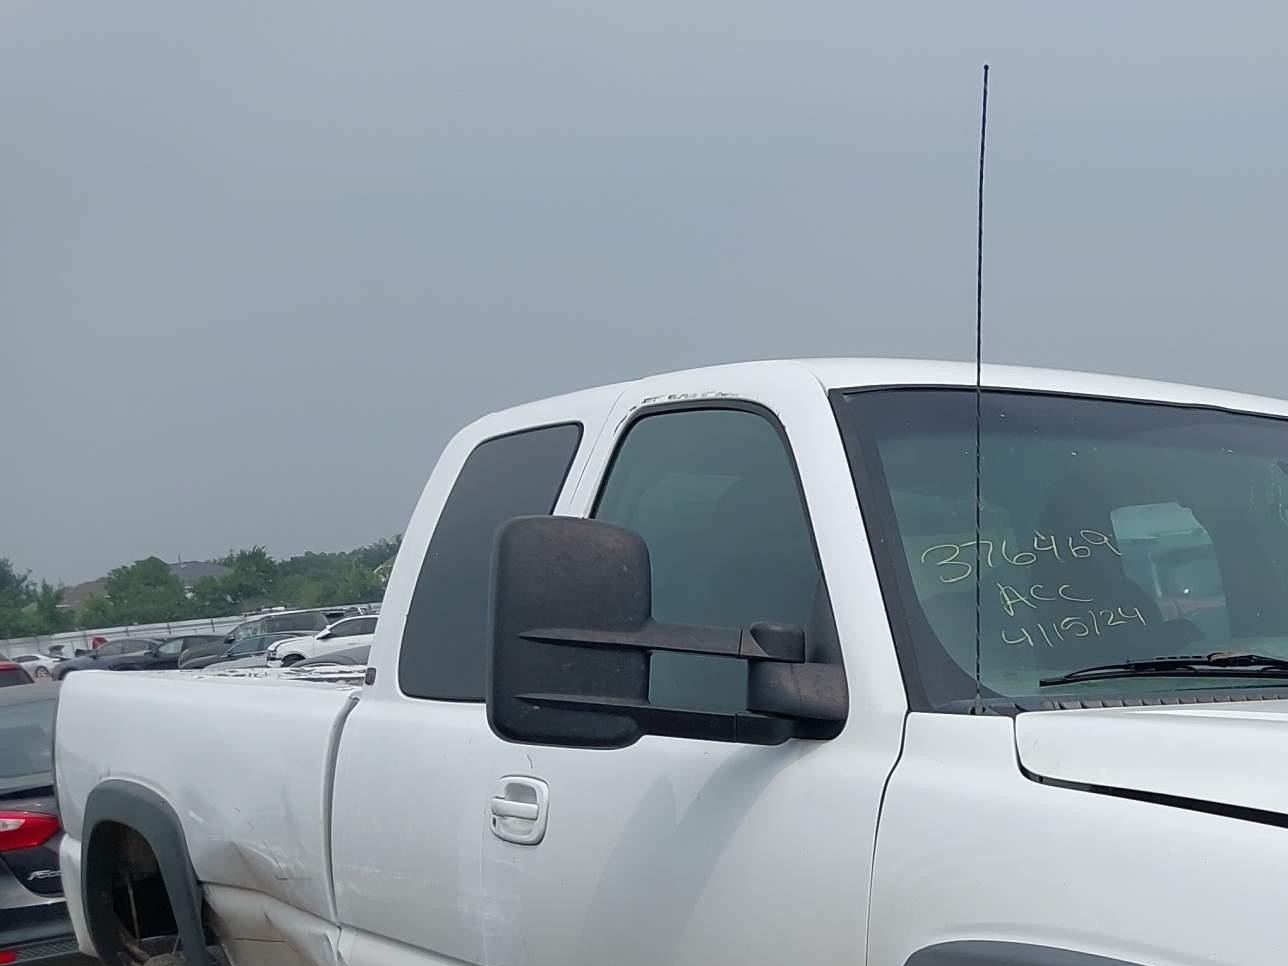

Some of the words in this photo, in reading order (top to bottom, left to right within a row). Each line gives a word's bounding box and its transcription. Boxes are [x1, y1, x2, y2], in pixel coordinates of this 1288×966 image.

[921, 530, 1122, 583] 376469
[996, 582, 1093, 617] ACC
[1001, 607, 1147, 648] 4/15/24
